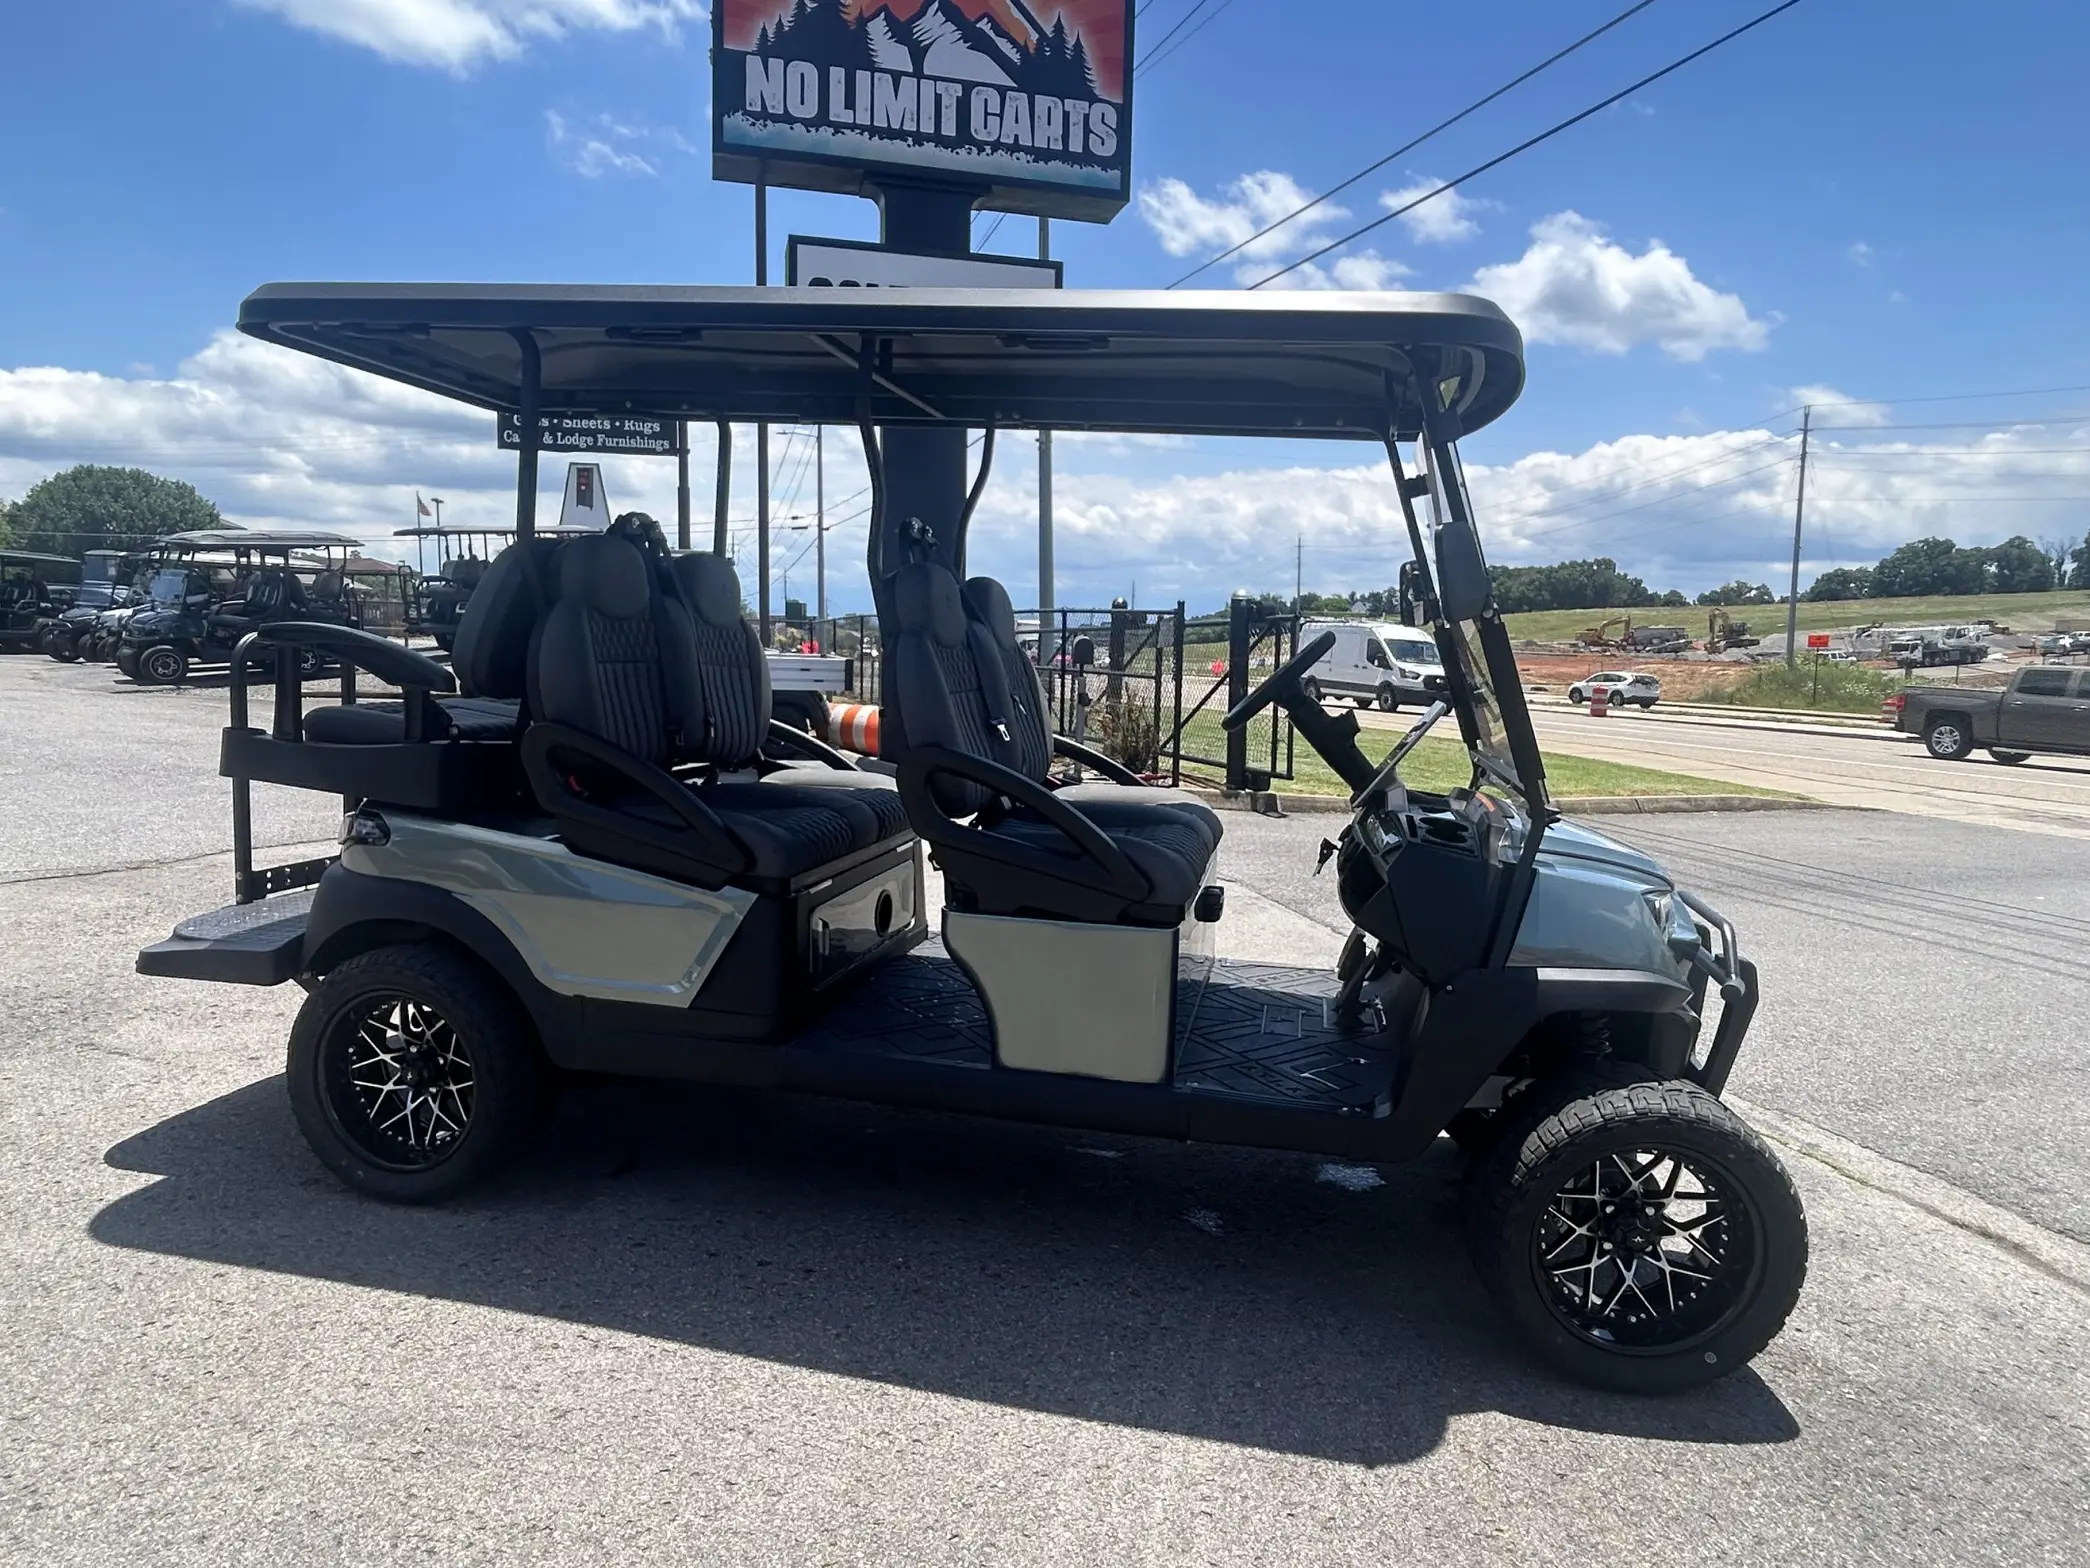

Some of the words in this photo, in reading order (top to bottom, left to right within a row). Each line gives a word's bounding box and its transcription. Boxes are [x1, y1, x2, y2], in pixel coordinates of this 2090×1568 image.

[745, 55, 818, 119] NO
[829, 66, 962, 137] LIMIT
[970, 86, 1117, 157] CARTS
[543, 432, 553, 444] &
[557, 432, 593, 448] Lodge
[597, 434, 670, 451] Furnishings
